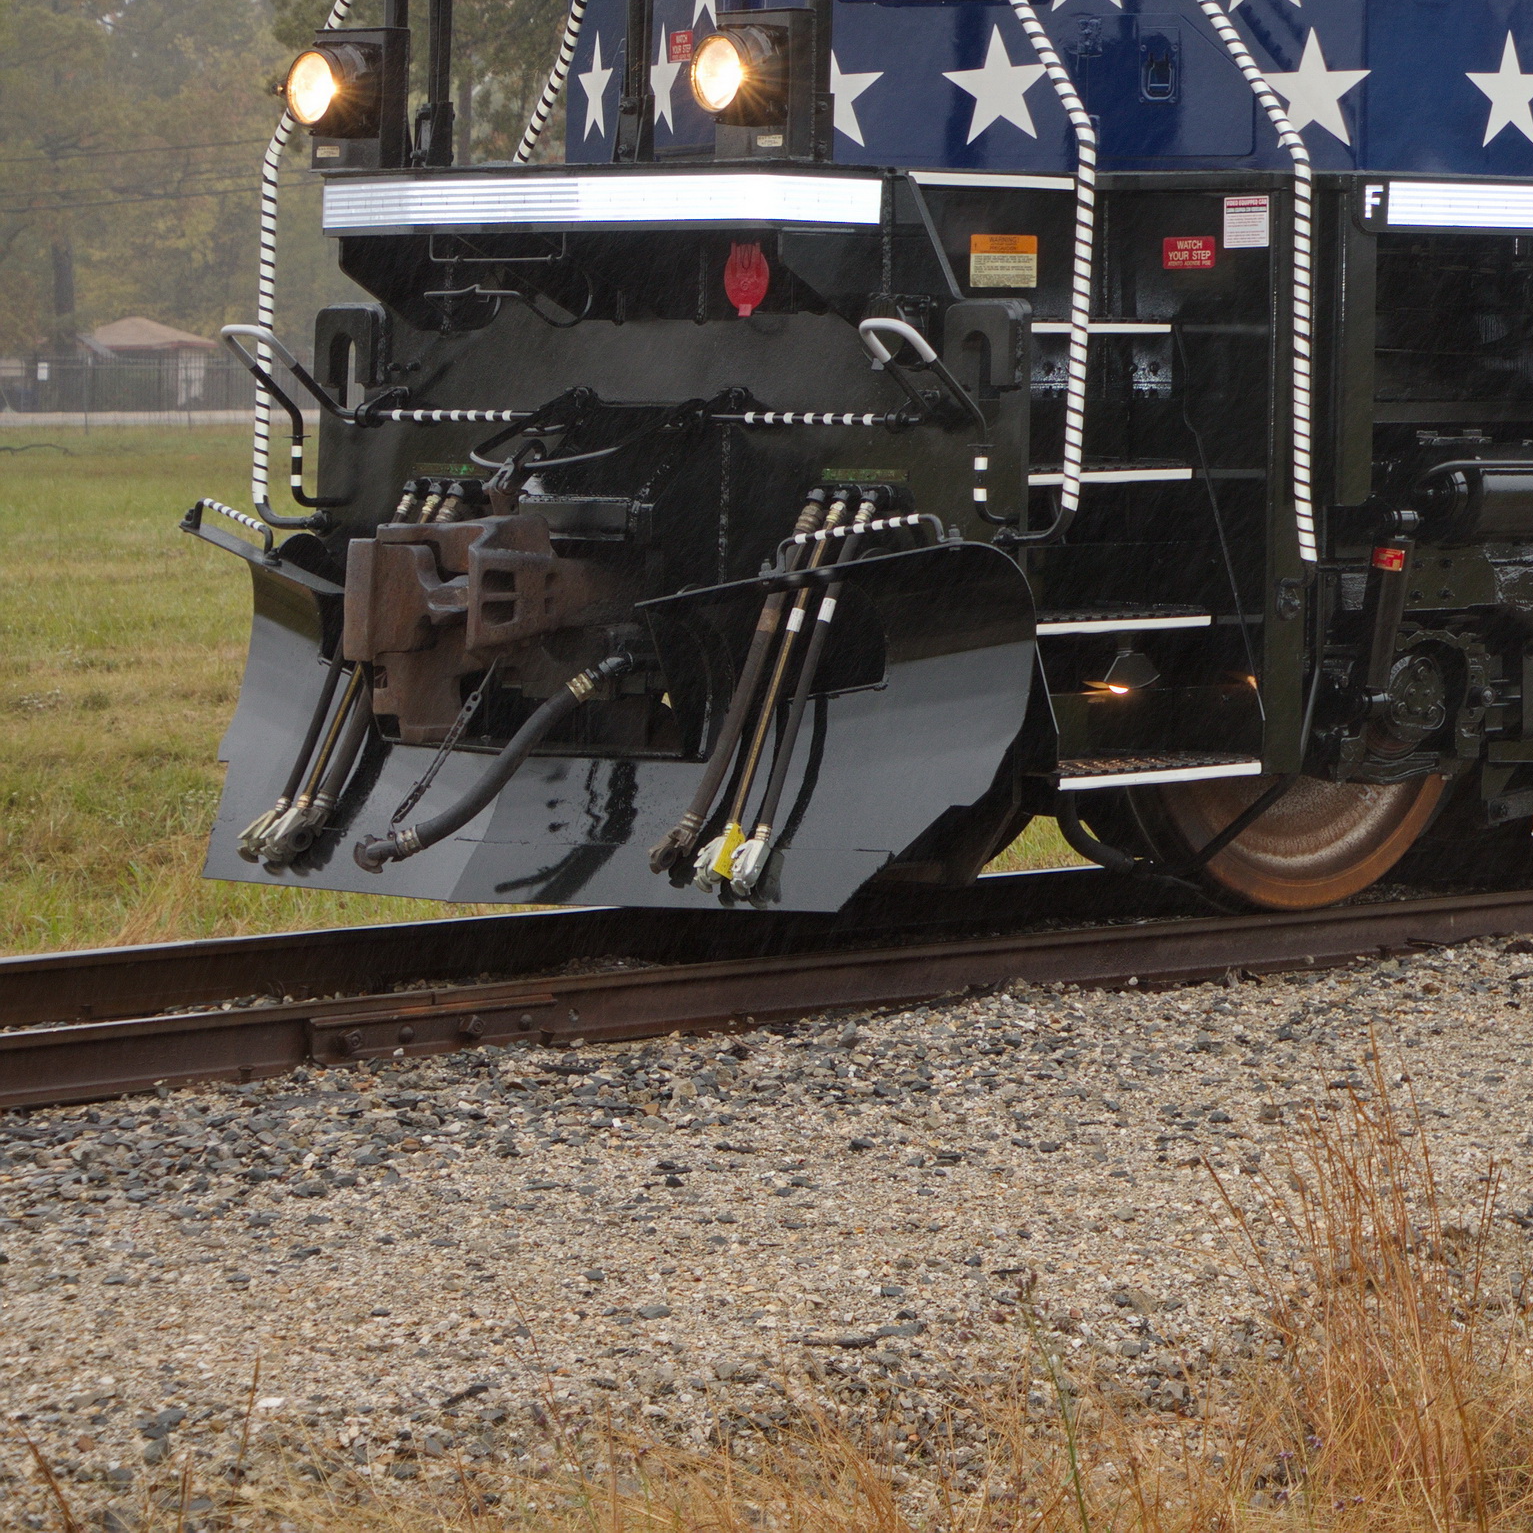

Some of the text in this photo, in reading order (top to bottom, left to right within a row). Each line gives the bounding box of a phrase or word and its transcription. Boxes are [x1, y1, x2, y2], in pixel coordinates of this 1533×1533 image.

[1365, 185, 1384, 219] F
[1176, 239, 1203, 250] WATCH
[1168, 250, 1212, 261] YOUR STEP
